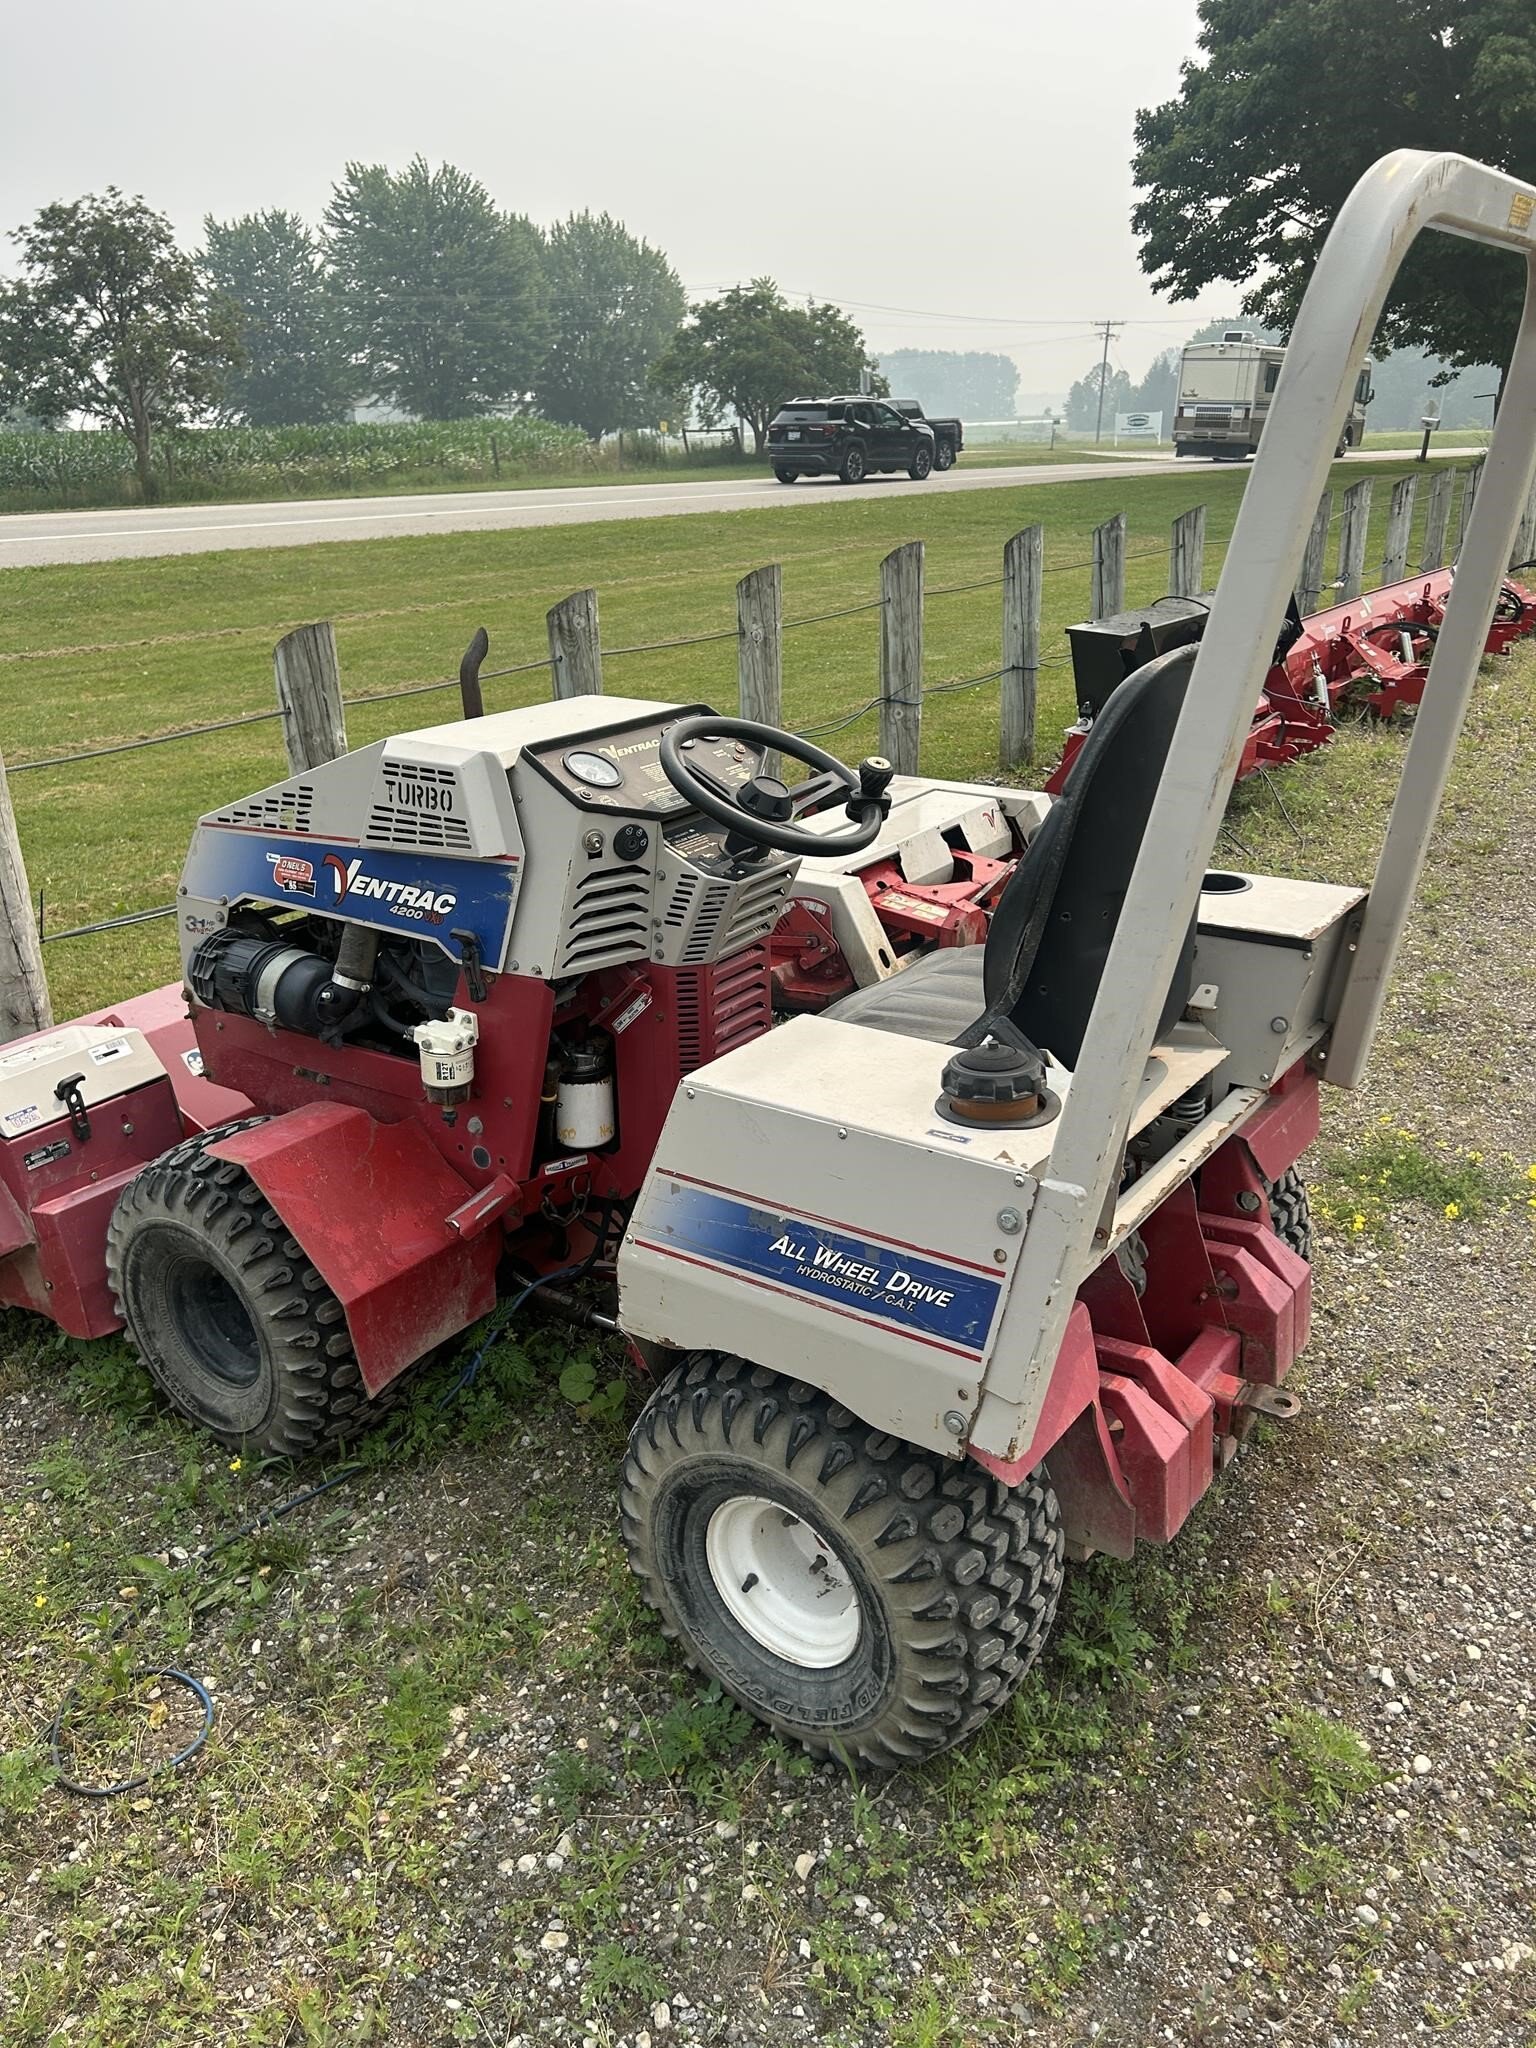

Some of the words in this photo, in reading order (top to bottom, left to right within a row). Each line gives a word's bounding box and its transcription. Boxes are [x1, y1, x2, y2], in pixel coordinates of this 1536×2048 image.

[598, 739, 660, 761] VENTRAC
[385, 780, 452, 812] TURBO
[323, 853, 456, 914] VENTRAC
[389, 905, 423, 920] 4200
[441, 1062, 449, 1080] R12T
[769, 1235, 806, 1261] ALL
[813, 1246, 880, 1285] WHEEL
[885, 1270, 954, 1308] DRIVE
[796, 1264, 873, 1297] HYDROSTATIC
[884, 1294, 917, 1311] C.A.T.
[689, 1625, 765, 1700] TRAX
[773, 1700, 853, 1722] FIELD
